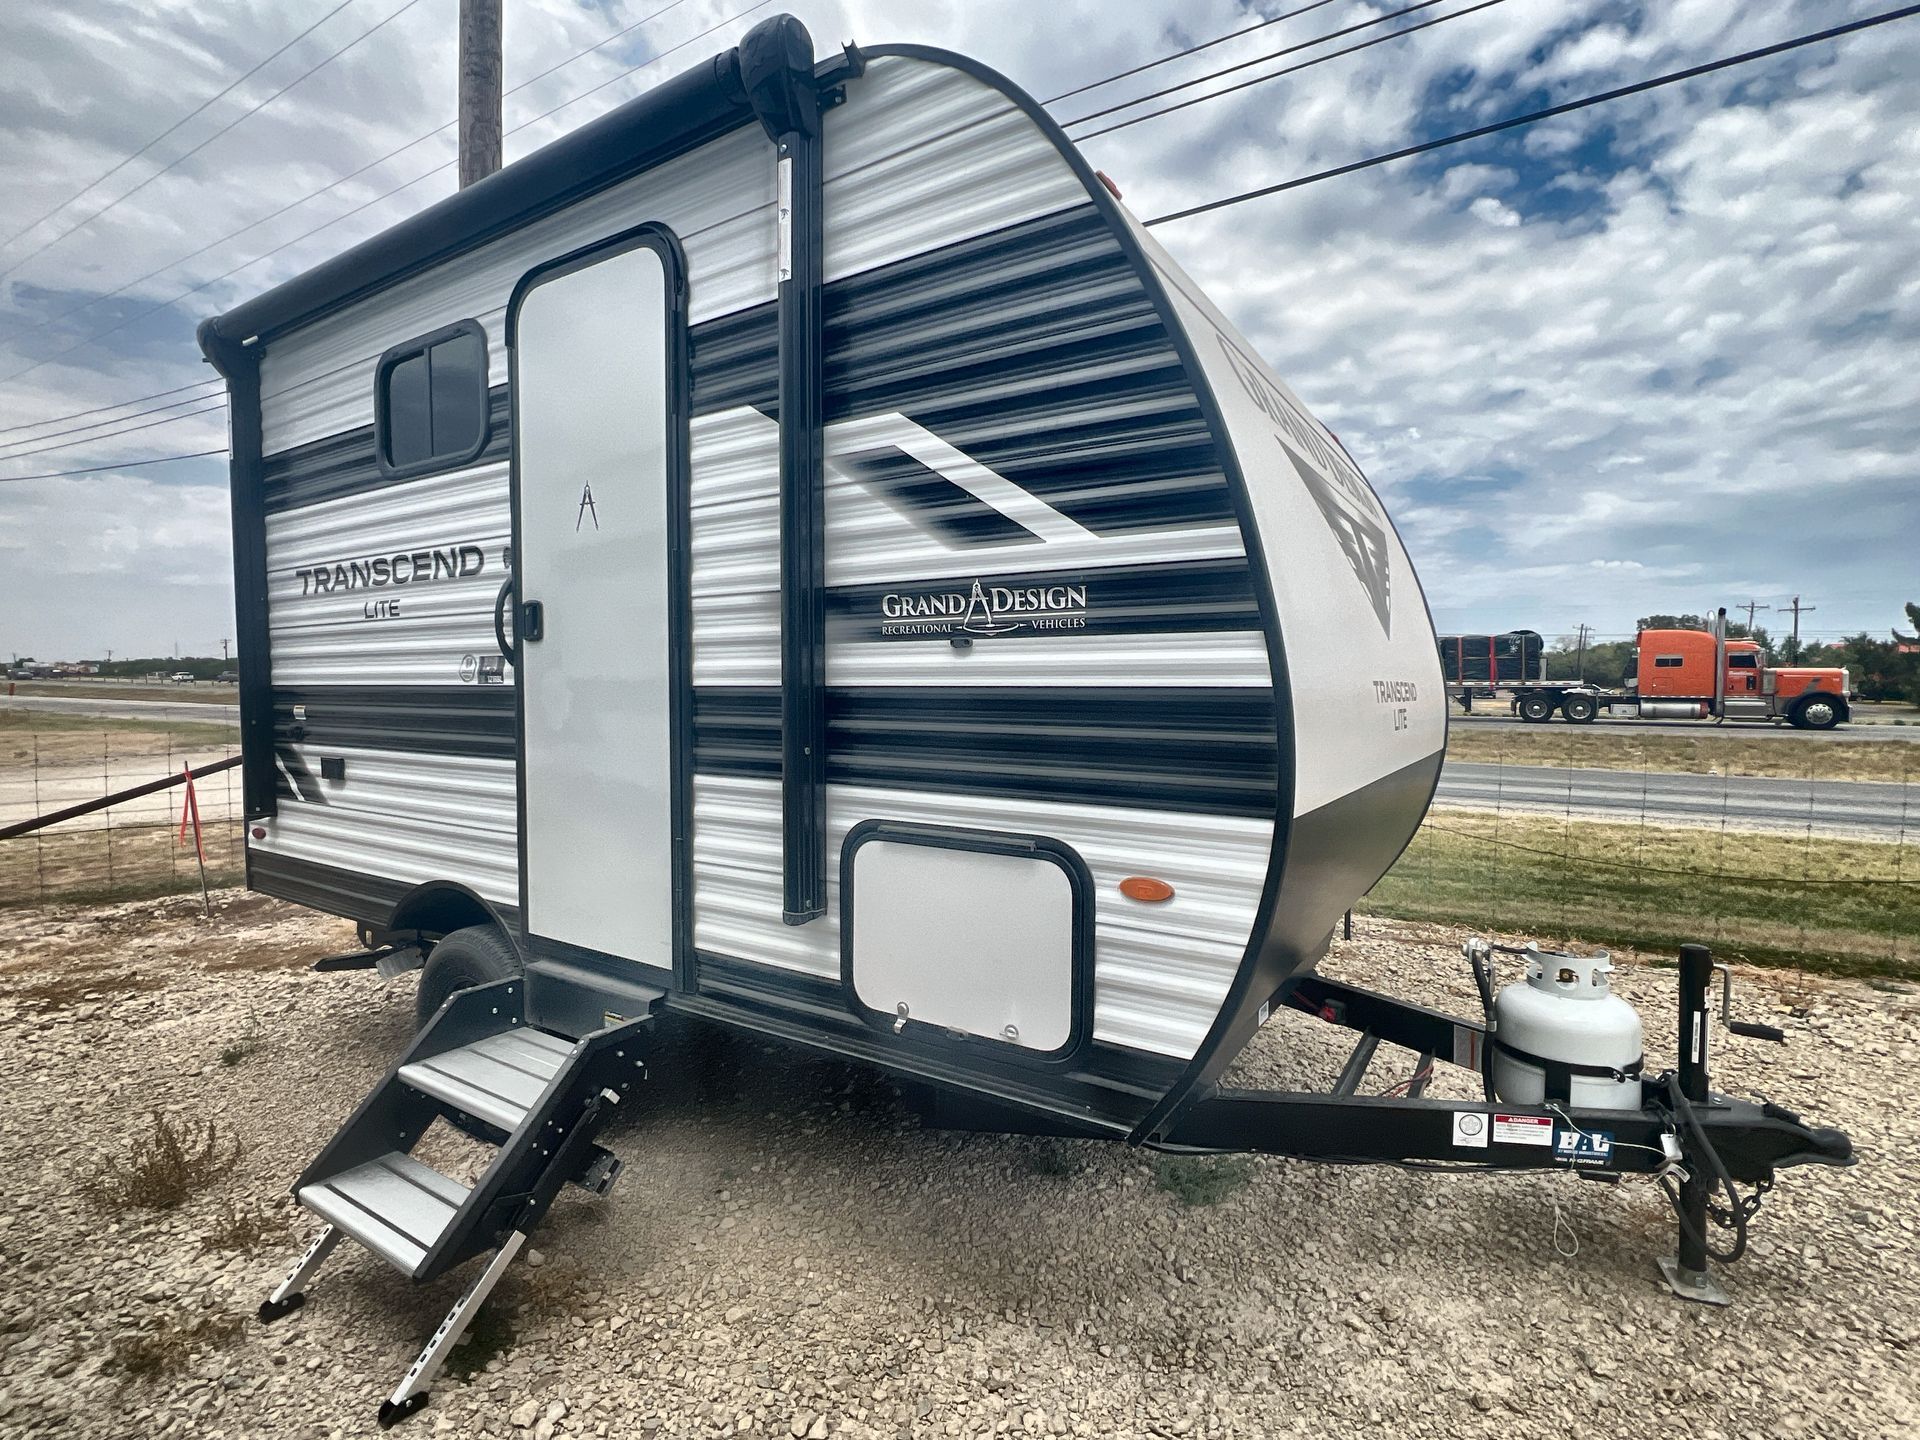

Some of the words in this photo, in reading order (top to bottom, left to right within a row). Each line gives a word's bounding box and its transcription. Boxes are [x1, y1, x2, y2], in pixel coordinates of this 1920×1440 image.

[296, 545, 484, 595] TRANSCEND
[364, 599, 400, 618] LITE
[882, 594, 965, 618] GRAND
[990, 586, 1087, 613] DESIGN
[882, 624, 952, 635] RECREATIONAL
[1031, 617, 1086, 629] VEHICLES
[1373, 680, 1418, 704] TRANSCEND
[1393, 708, 1408, 731] LITE
